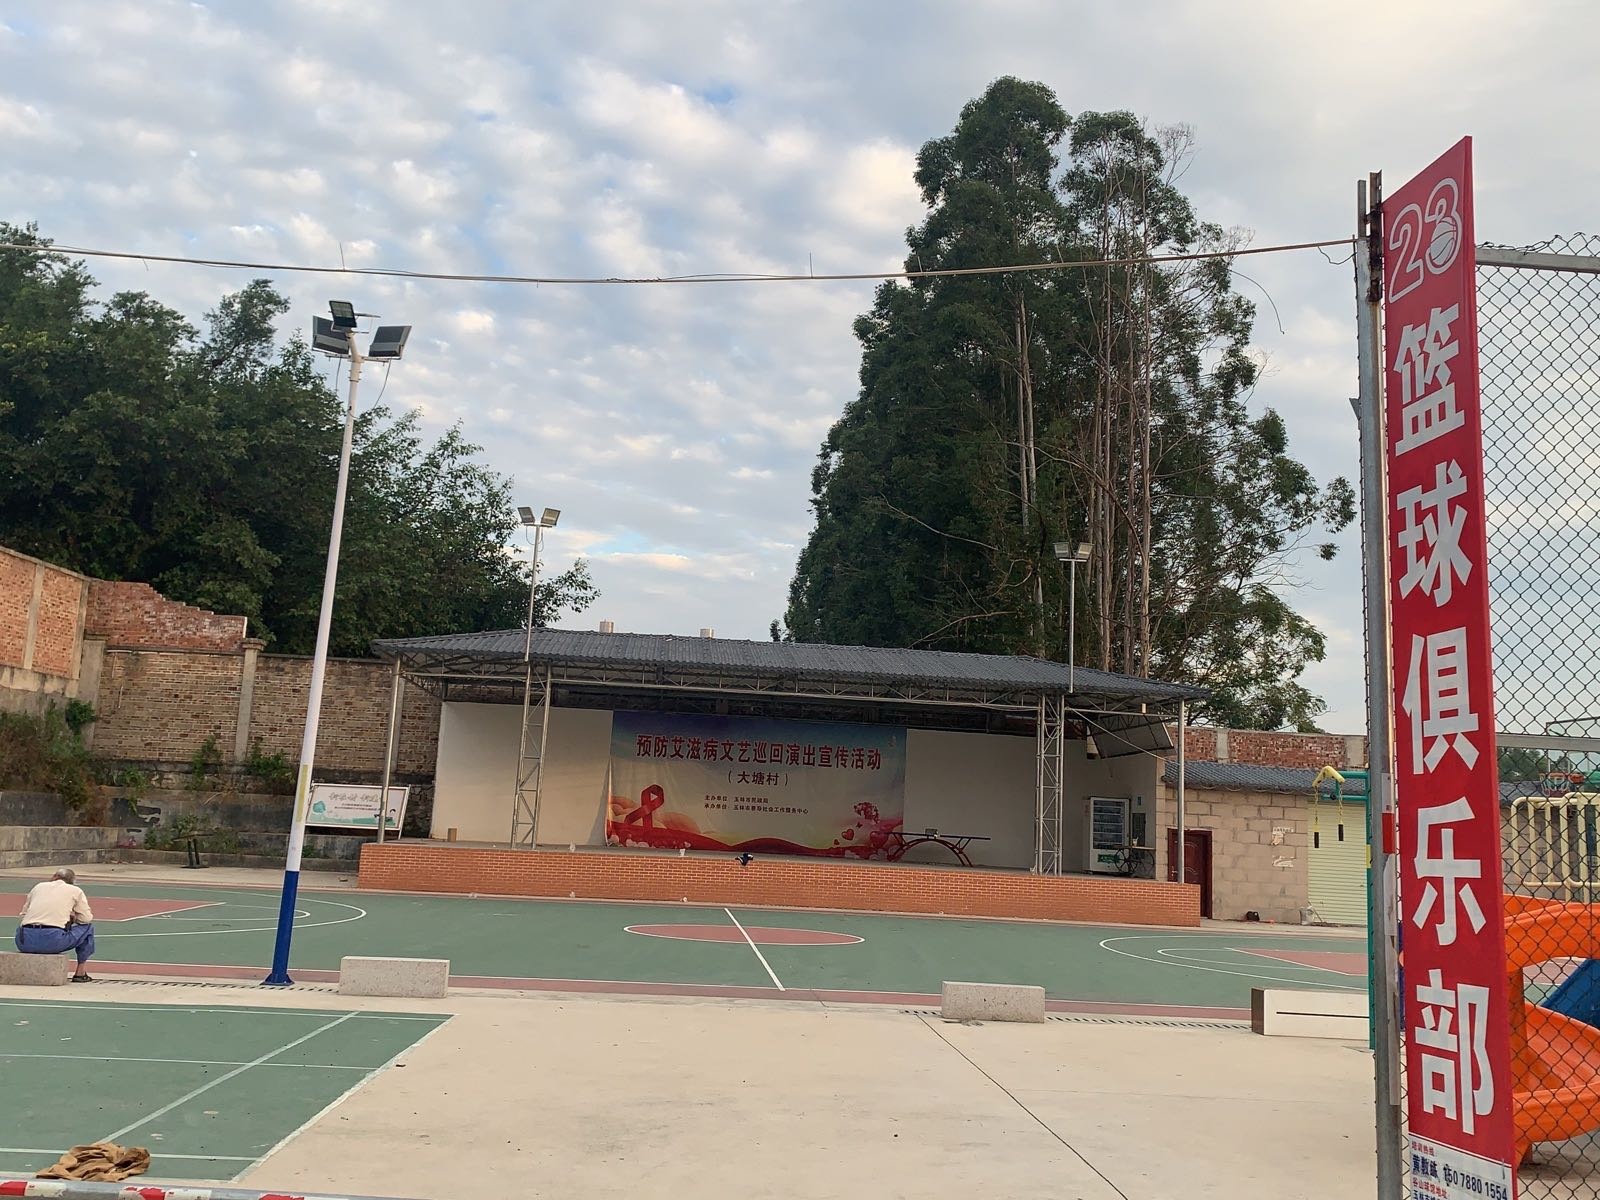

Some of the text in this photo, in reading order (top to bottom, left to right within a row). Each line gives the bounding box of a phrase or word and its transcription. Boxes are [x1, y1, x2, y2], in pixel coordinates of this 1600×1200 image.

[1393, 302, 1495, 1136] 篮球俱乐部
[636, 734, 881, 770] 预防艾滋病文艺巡回演出宣传活动
[1412, 1154, 1438, 1178] 黄教练
[1460, 1172, 1482, 1194] 7880
[1485, 1181, 1508, 1200] 1554
